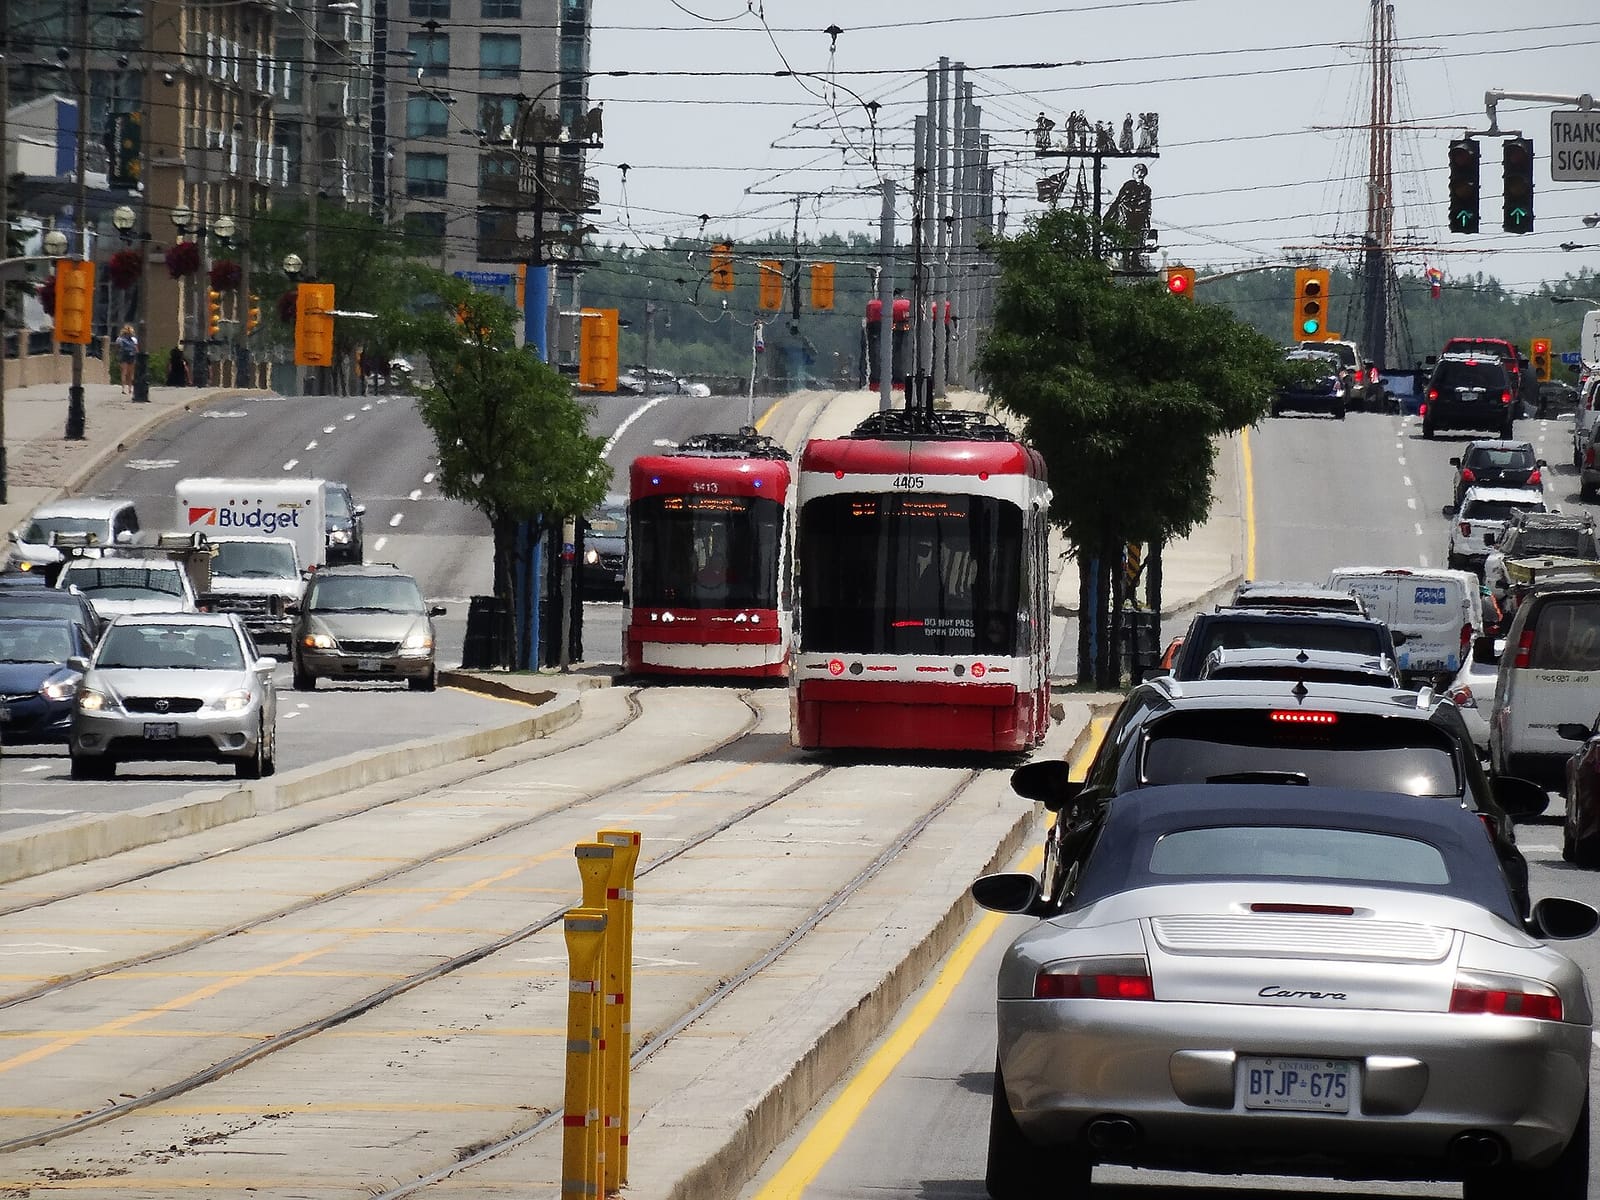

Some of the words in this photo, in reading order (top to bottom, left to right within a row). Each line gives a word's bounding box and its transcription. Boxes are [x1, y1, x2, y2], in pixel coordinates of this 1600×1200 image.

[893, 476, 924, 489] 4405
[219, 508, 299, 534] Budget
[924, 618, 936, 627] DO
[938, 618, 953, 627] NOT
[955, 619, 974, 628] PASS
[924, 628, 947, 636] OPEN
[949, 628, 976, 638] DOORS
[1258, 985, 1347, 1000] Carrera
[1278, 1062, 1320, 1073] ONTARIO
[1250, 1069, 1298, 1096] BTJP
[1310, 1073, 1347, 1099] 675
